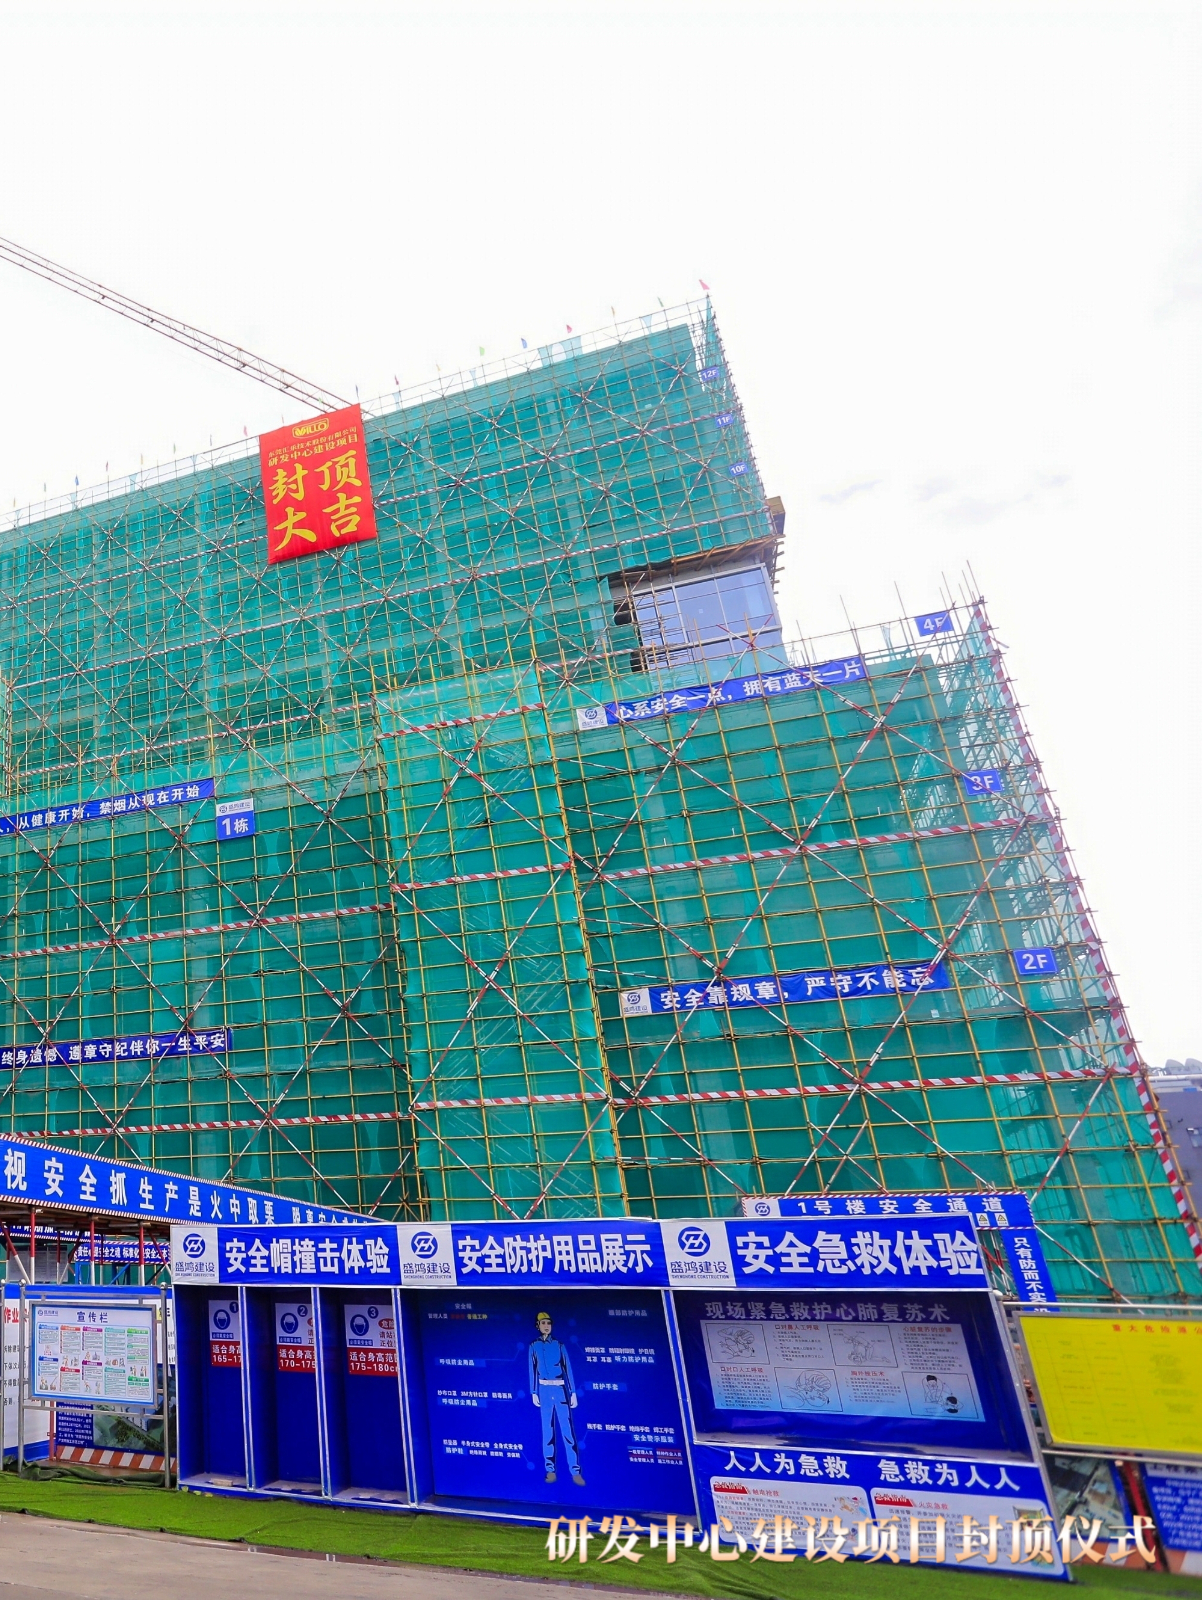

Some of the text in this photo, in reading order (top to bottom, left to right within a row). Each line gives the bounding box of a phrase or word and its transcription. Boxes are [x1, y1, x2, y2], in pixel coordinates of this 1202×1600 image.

[702, 369, 717, 379] 12F
[717, 415, 731, 425] 11F
[294, 421, 328, 438] VILLO
[268, 426, 357, 458] 东莞汇乐技术股份有限公司
[268, 435, 358, 467] 研发中心建设项目
[268, 450, 363, 505] 封顶
[730, 464, 746, 474] 10F
[273, 492, 362, 552] 大吉
[922, 616, 944, 632] 4F
[971, 774, 995, 791] 3F
[221, 817, 249, 836] 1栋
[1021, 953, 1049, 971] 2F
[68, 1033, 225, 1061] 遵章守纪伴你一生平安
[798, 1196, 1005, 1215] 1号楼安全通道
[225, 1237, 391, 1274] 安全帽撞击体验
[458, 1233, 654, 1274] 安全防护用品展示
[736, 1230, 985, 1276] 安全急救体验
[175, 1261, 215, 1273] 盛鸿建设
[403, 1262, 451, 1275] 盛鸿建设
[670, 1260, 728, 1275] 盛鸿建设
[77, 1311, 108, 1323] 宣传栏
[299, 1306, 307, 1316] 2
[369, 1307, 377, 1318] 3
[704, 1301, 950, 1322] 现场紧急救护心肺复苏术
[724, 1450, 1021, 1492] 人人为急救 急救为人人
